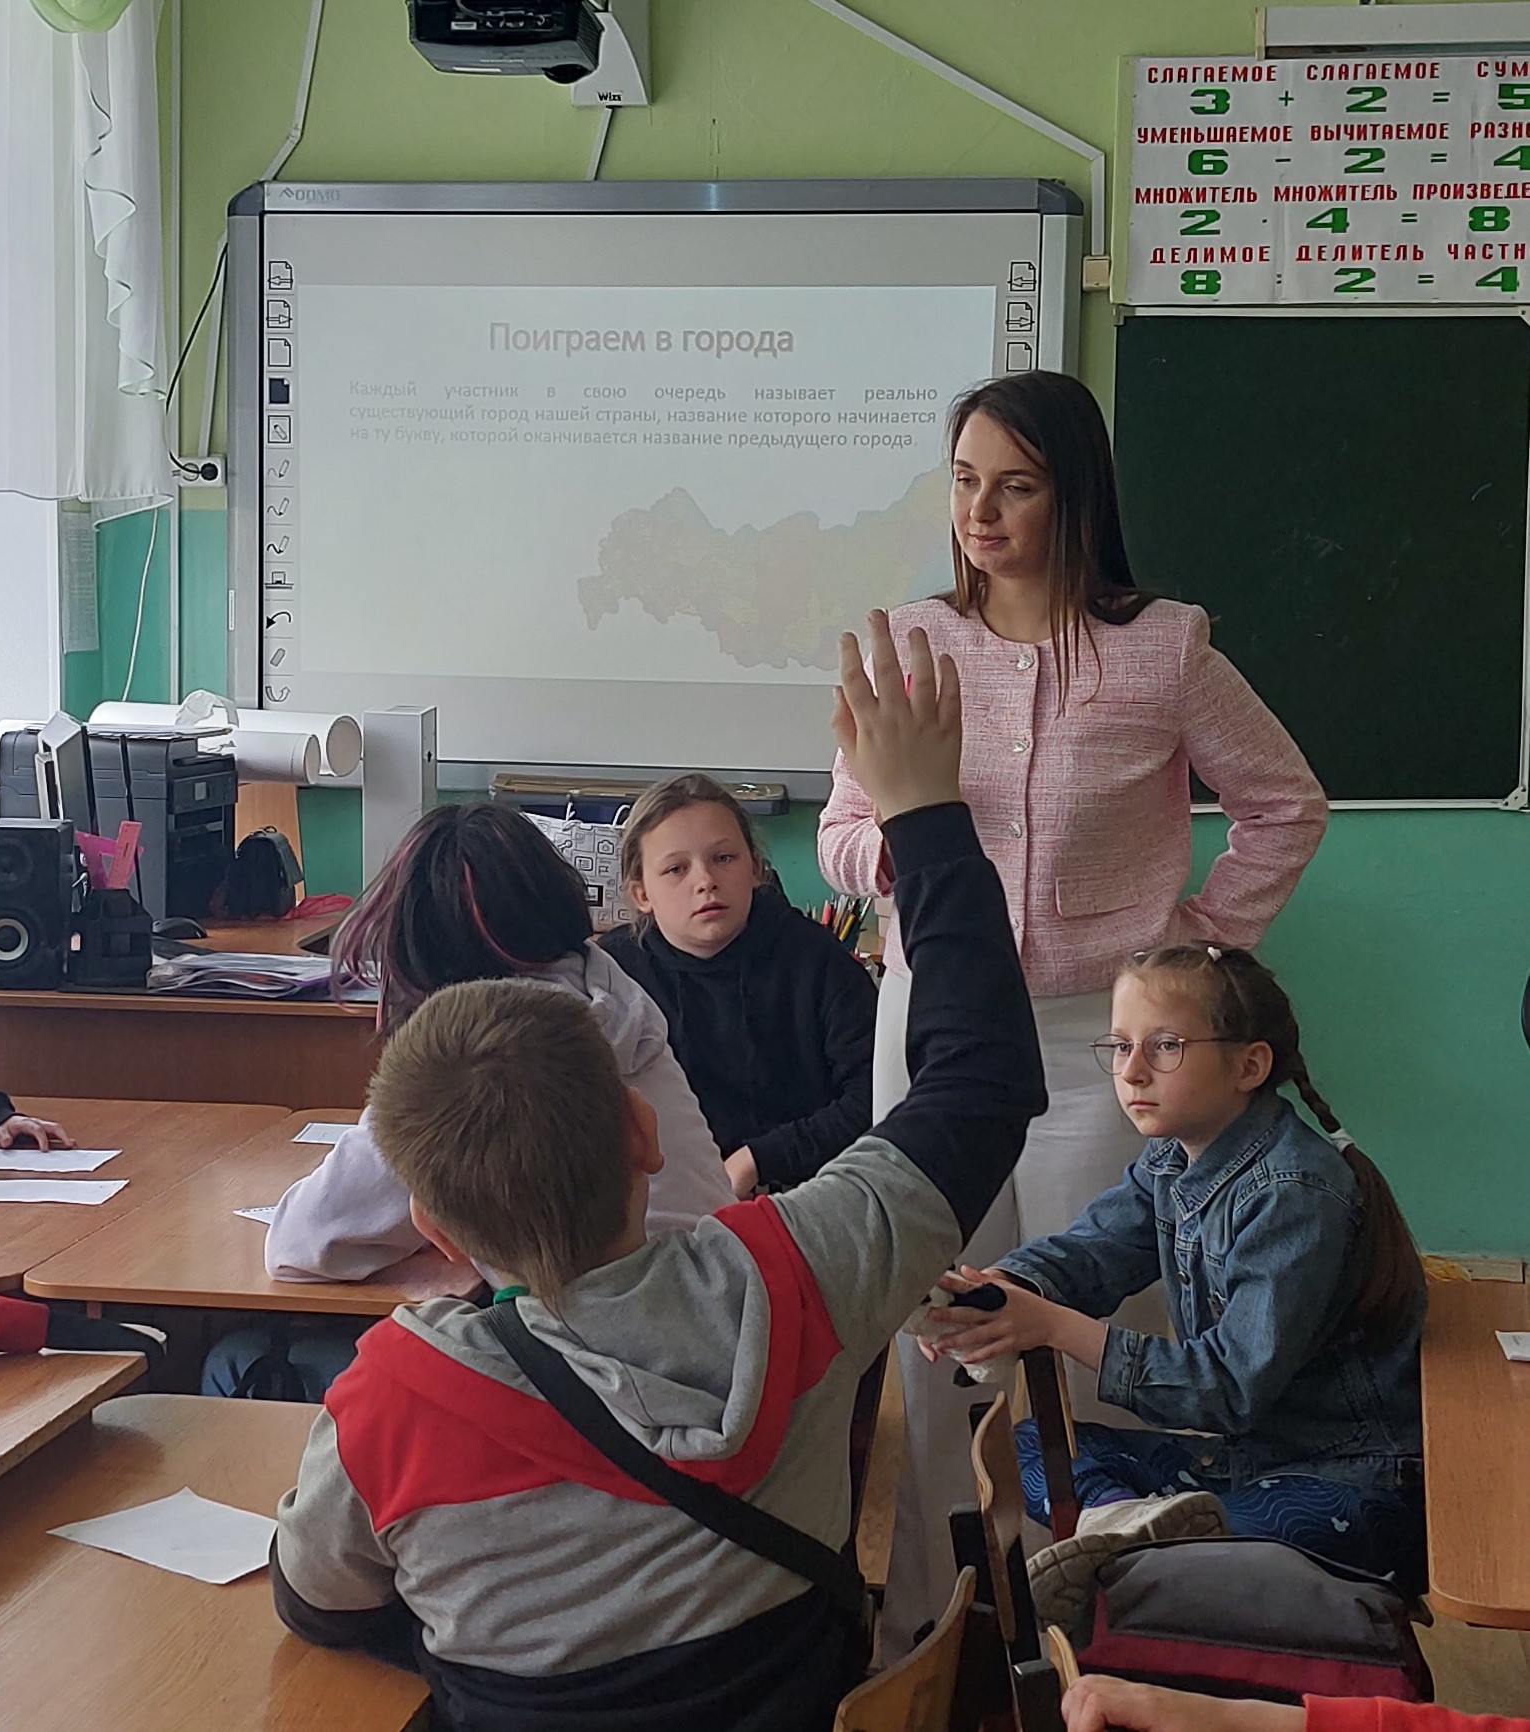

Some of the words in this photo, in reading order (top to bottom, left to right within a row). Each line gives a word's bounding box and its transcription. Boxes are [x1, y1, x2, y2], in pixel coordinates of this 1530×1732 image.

[1147, 65, 1278, 84] СЛАГАЕМОЕ
[1306, 62, 1440, 81] СЛАГАЕМОЕ
[1477, 60, 1529, 78] СУМ
[1189, 88, 1231, 116] 3
[1345, 86, 1388, 113] 2
[1497, 83, 1530, 110] 5
[1137, 125, 1293, 144] УМЕНЬШАЕМОЕ
[1310, 122, 1449, 142] ВЫЧИТАЕМОЕ
[1187, 148, 1229, 176] 6
[1343, 147, 1386, 174] 2
[1493, 145, 1530, 171] 4
[1135, 186, 1258, 205] МНОЖИТЕЛЬ
[1273, 184, 1398, 202] МНОЖИТЕЛЬ
[1412, 181, 1530, 201] ПРОИЗВЕДЕ
[1179, 209, 1221, 236] 2
[1305, 207, 1350, 234] 4
[1468, 205, 1511, 232] 8
[1149, 245, 1271, 264] ДЕЛИМОЕ
[1295, 244, 1424, 262] ДЕЛИТЕЛЬ
[1447, 243, 1526, 261] ЧАСТН
[1180, 269, 1222, 295] 8
[1333, 267, 1377, 293] 2
[1475, 266, 1520, 293] 4
[489, 322, 646, 359] Поиграем
[655, 330, 673, 353] в
[682, 330, 794, 360] города
[349, 379, 417, 400] Каждый
[443, 385, 519, 401] участник
[546, 386, 556, 399] в
[583, 386, 627, 399] свою
[654, 387, 727, 403] очередь
[754, 388, 837, 401] называет
[864, 388, 938, 405] реально
[349, 403, 475, 423] существующий
[480, 408, 531, 424] город
[535, 404, 590, 422] нашей
[595, 410, 661, 426] страны,
[667, 410, 748, 423] название
[753, 411, 832, 427] которого
[837, 411, 937, 424] начинается
[349, 427, 370, 440] на
[373, 427, 391, 444] ту
[449, 426, 519, 447] которой
[523, 431, 637, 445] оканчивается
[643, 432, 723, 446] название
[728, 433, 848, 450] предыдущего
